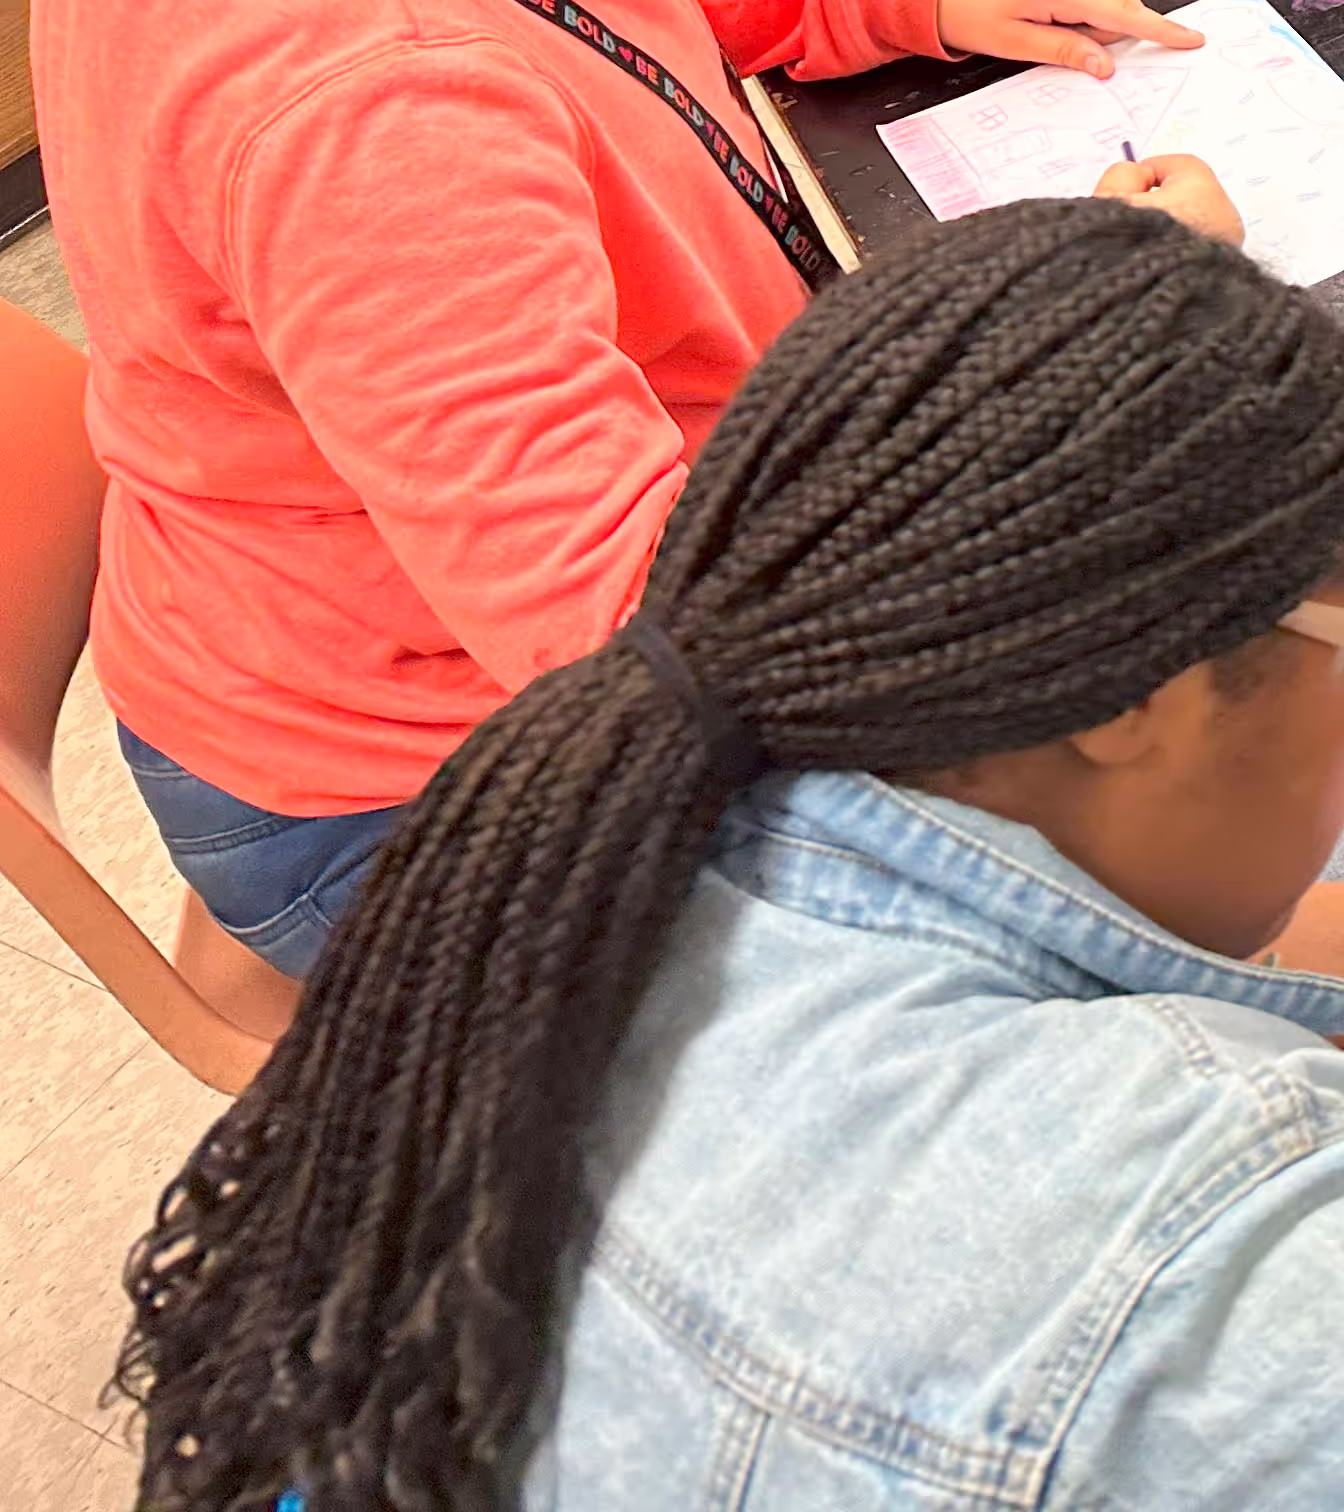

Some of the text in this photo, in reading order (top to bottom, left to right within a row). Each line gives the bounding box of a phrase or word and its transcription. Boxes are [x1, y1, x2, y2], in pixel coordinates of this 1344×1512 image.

[564, 5, 616, 54] BOLD
[636, 55, 659, 86] BE
[664, 77, 704, 126] BOLD
[713, 135, 730, 164] BE
[729, 154, 763, 202] BOLD
[771, 206, 790, 234] BE
[785, 225, 822, 271] BOLD
